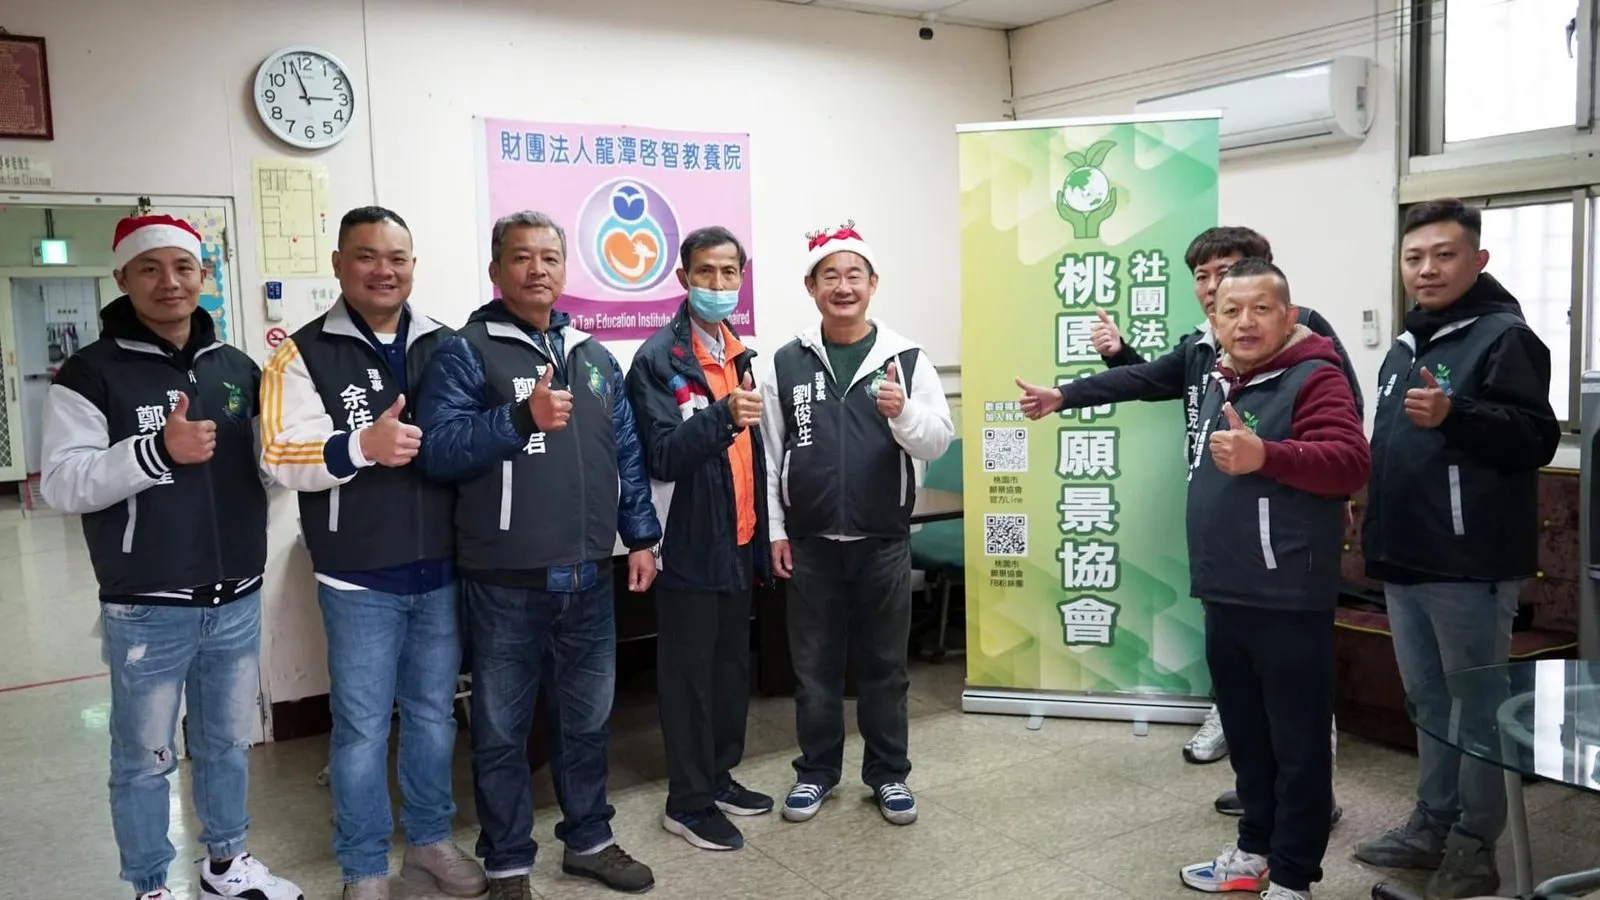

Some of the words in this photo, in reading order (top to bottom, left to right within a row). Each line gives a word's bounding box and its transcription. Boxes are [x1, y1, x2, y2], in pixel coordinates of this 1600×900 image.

[282, 61, 294, 75] 11
[298, 57, 312, 71] 12
[322, 63, 327, 77] 1
[269, 73, 286, 87] 10
[332, 77, 343, 90] 2
[264, 89, 276, 103] 9
[338, 93, 349, 106] 3
[271, 106, 283, 120] 8
[333, 109, 344, 122] 4
[285, 119, 296, 133] 7
[304, 125, 315, 139] 6
[322, 121, 333, 134] 5
[1131, 252, 1167, 362] 社團法
[577, 314, 595, 331] Tan
[596, 312, 636, 329] Education
[637, 311, 671, 328] Institute
[367, 368, 384, 392] 理事
[793, 383, 813, 447] 劉俊生
[985, 411, 1024, 421] 加入我們
[993, 476, 1018, 484] 桃園市
[989, 486, 1022, 494] 願景協會
[995, 560, 1019, 569] 桃園市
[990, 569, 1023, 578] 願景協會
